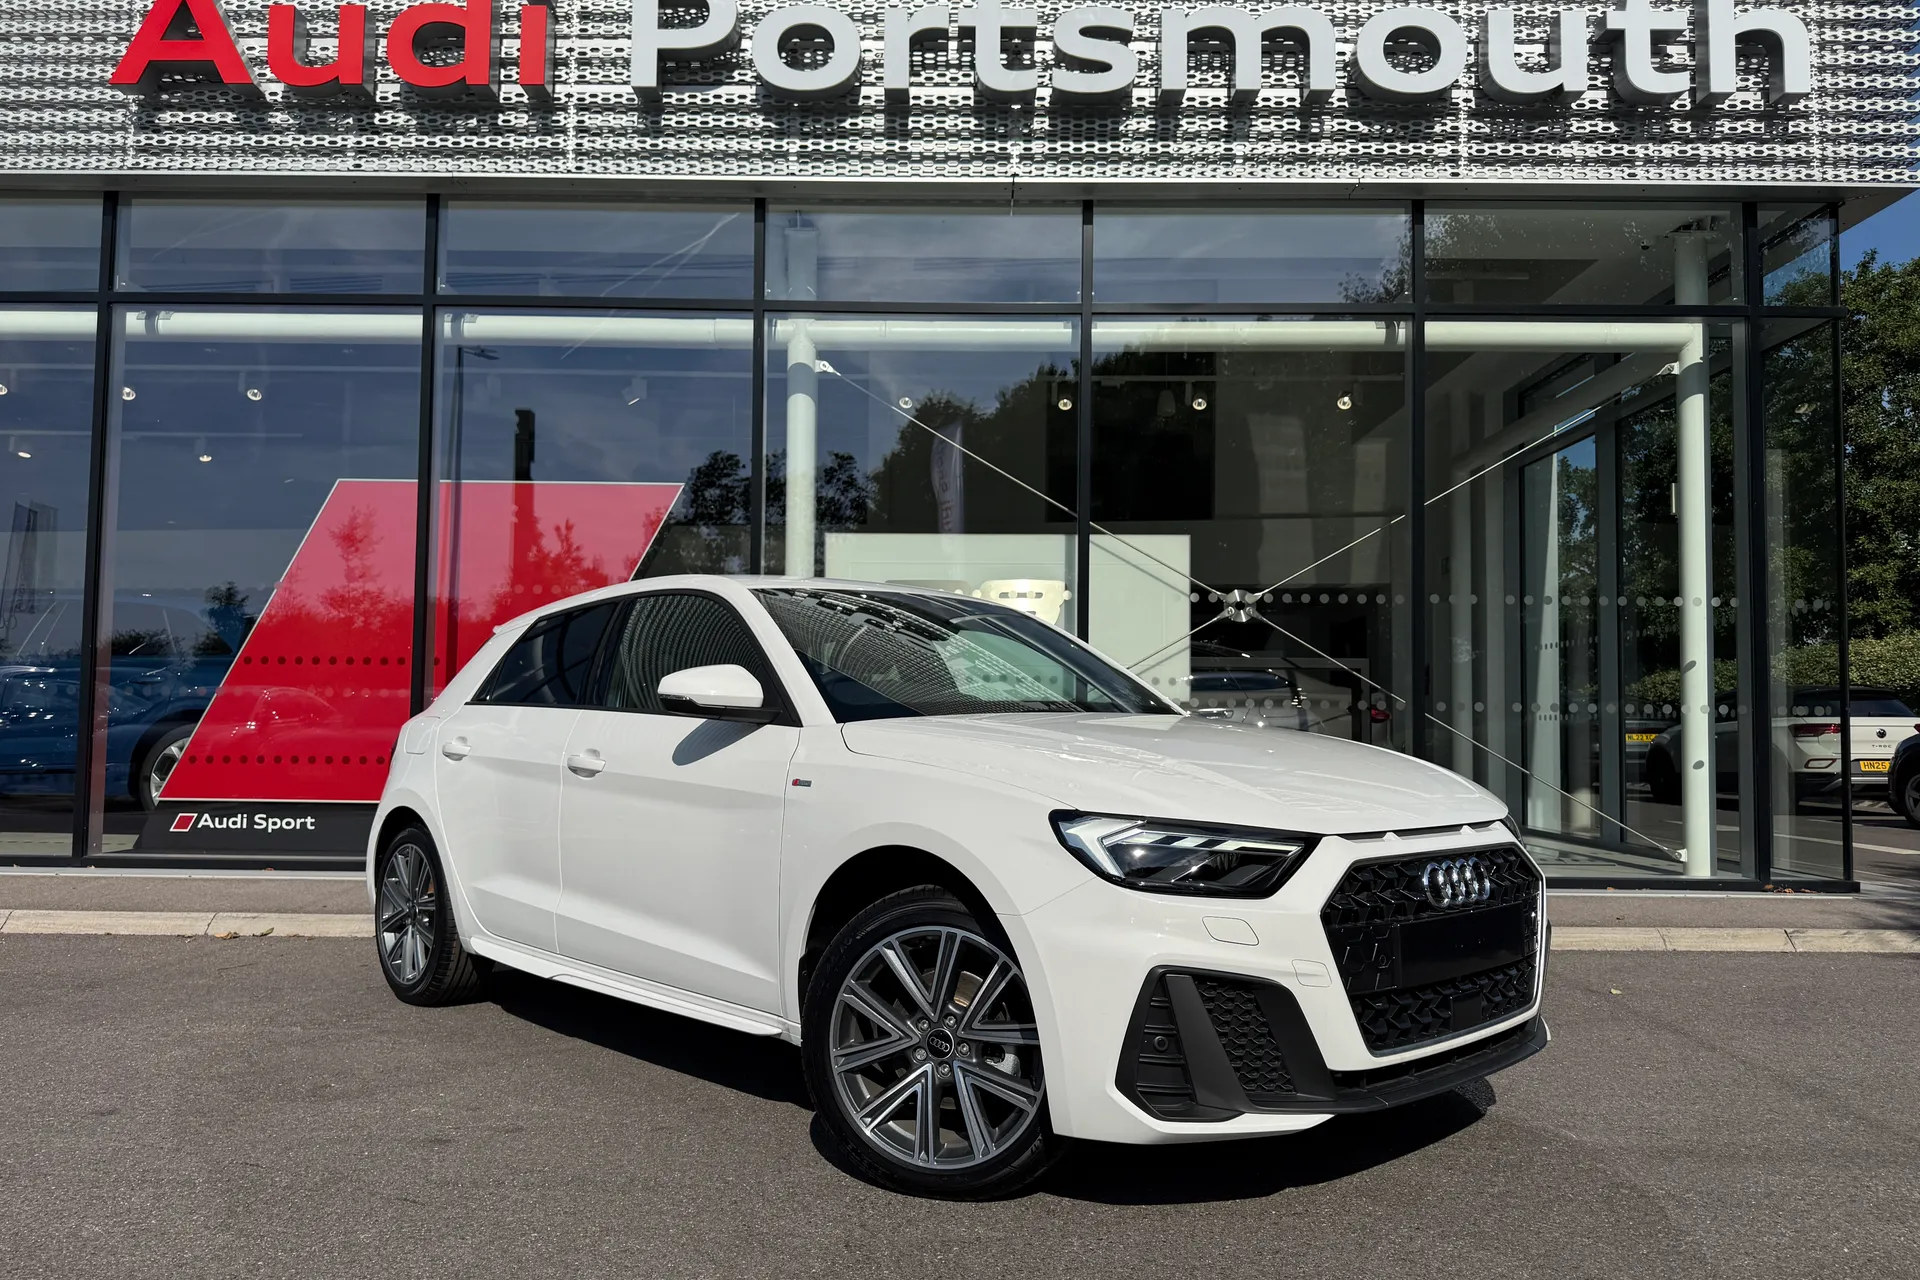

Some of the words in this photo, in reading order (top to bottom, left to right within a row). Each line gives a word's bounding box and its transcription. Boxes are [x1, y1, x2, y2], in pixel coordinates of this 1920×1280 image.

[108, 0, 548, 88] Audi
[630, 0, 1811, 95] Portsmouth
[1863, 761, 1887, 770] HN25
[197, 813, 247, 829] Audi
[253, 814, 315, 832] Sport
